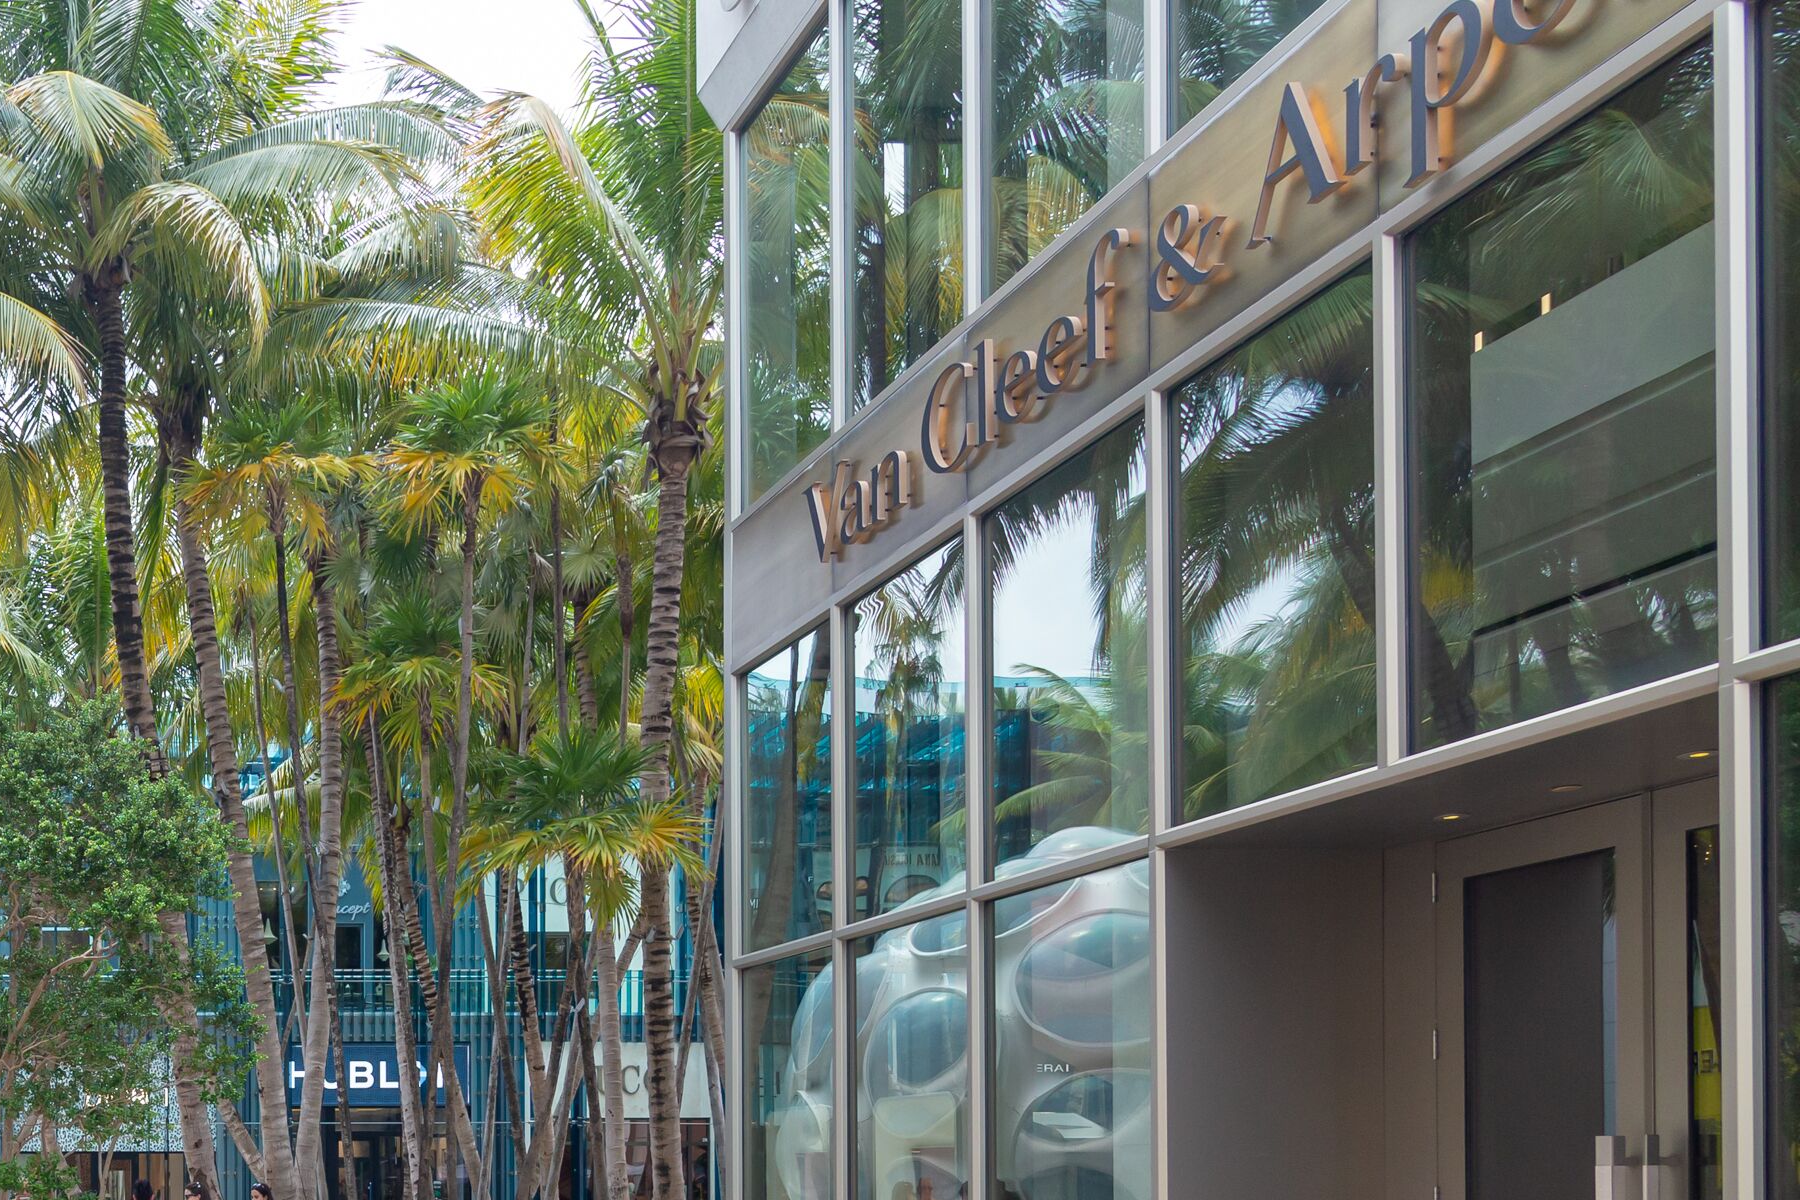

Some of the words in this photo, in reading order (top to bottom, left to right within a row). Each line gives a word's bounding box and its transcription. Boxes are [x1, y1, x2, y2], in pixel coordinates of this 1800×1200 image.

[802, 457, 909, 564] Van
[920, 228, 1130, 474] Cleef
[1149, 204, 1227, 312] &
